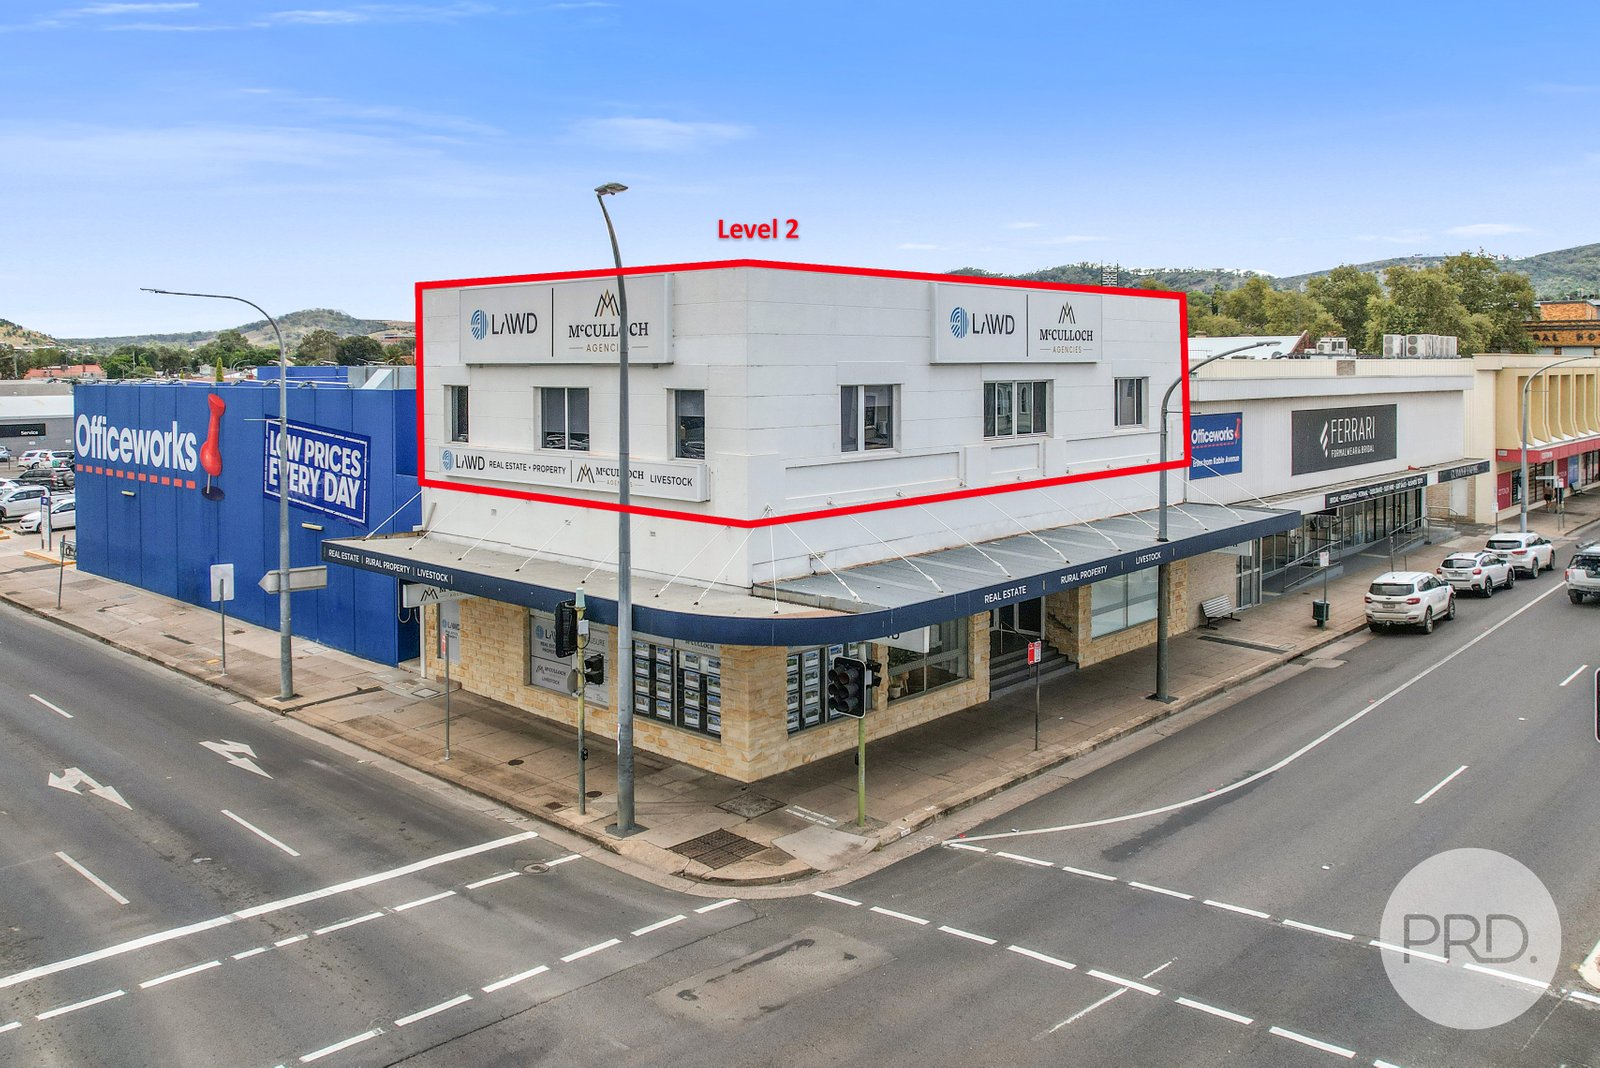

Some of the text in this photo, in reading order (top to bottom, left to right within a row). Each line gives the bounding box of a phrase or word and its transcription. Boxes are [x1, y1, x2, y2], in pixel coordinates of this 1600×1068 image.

[491, 313, 538, 335] LAWD
[568, 322, 649, 338] McCULLCH
[972, 313, 1015, 335] LAWD
[1039, 328, 1094, 342] McCULLOCH
[586, 343, 629, 352] AGENCI
[1052, 345, 1082, 354] AGENCIES
[1191, 426, 1234, 444] Officeworks
[1330, 415, 1375, 444] FERRARI
[75, 414, 198, 472] Officeworks
[304, 438, 362, 478] PRICES
[455, 454, 567, 475] LAWD REAL ESTATE PROPERTY
[595, 467, 693, 487] McCULOCH LIVESTOCK
[323, 471, 361, 510] DAY
[328, 549, 449, 583] REAL ESTATE RURAL PROPERTY LIVESTOCK
[984, 551, 1162, 604] REAL ESTATE RURAL PROPERTY LIVESTOCK
